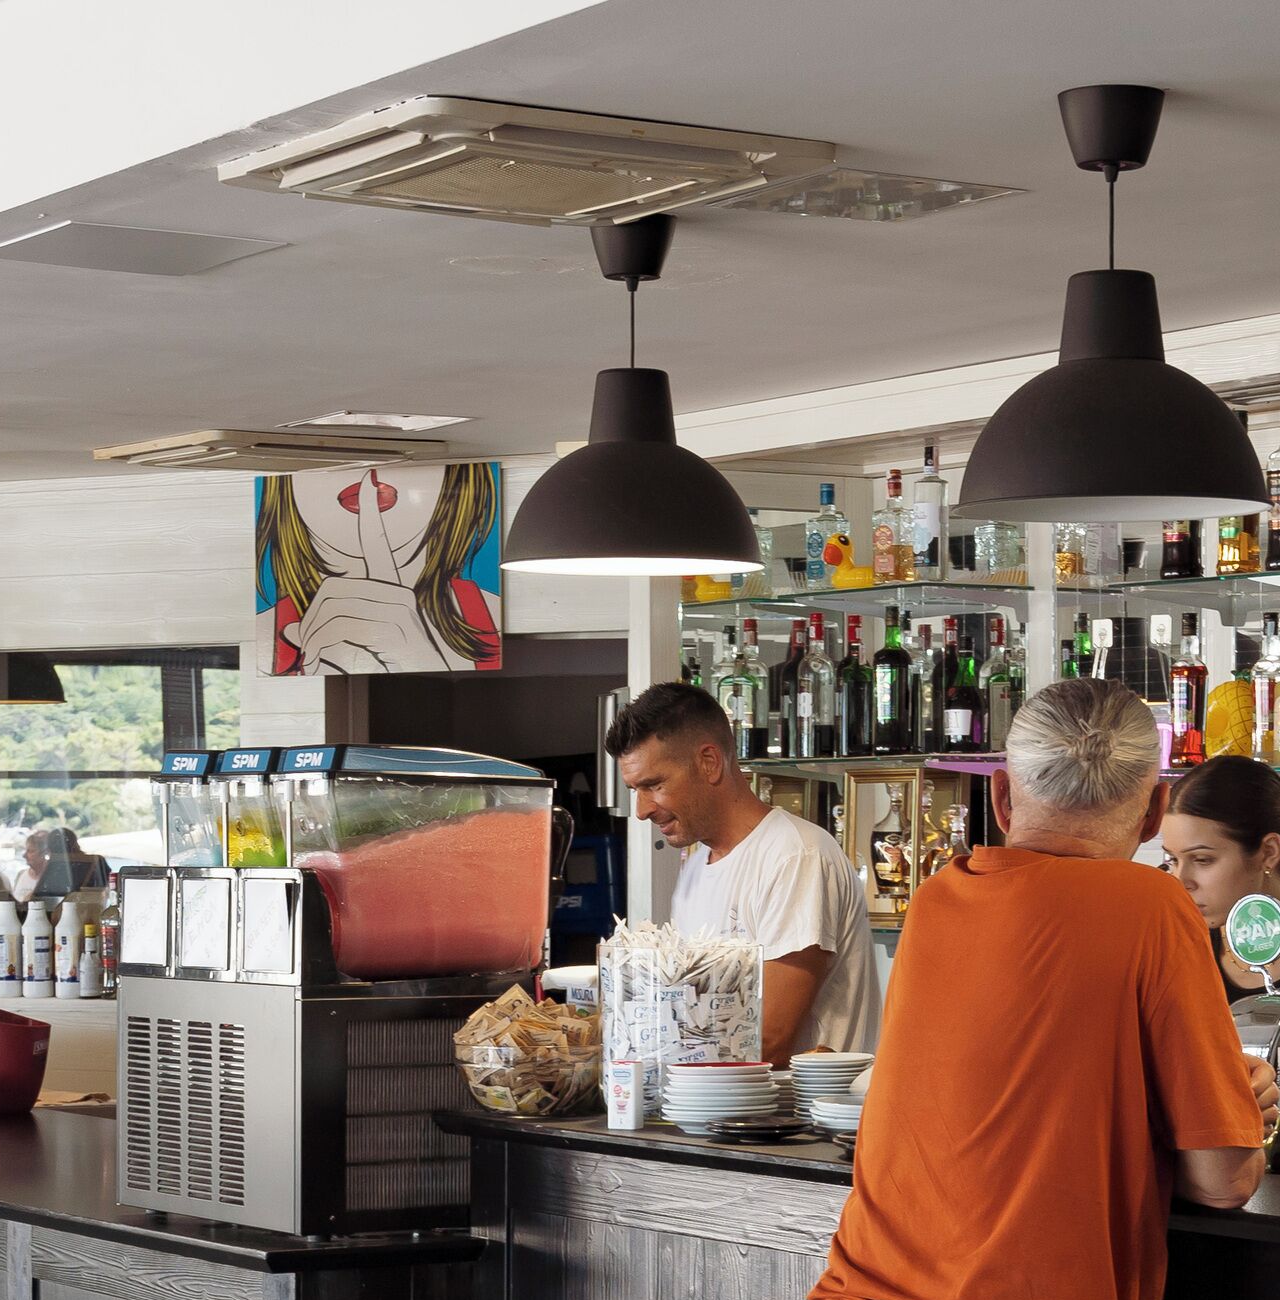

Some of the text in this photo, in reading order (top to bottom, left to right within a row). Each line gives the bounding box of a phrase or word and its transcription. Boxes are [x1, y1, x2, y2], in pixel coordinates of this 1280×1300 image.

[171, 756, 199, 772] SPM
[231, 753, 260, 769] SPM
[294, 752, 325, 769] SPM
[556, 895, 583, 910] PSI
